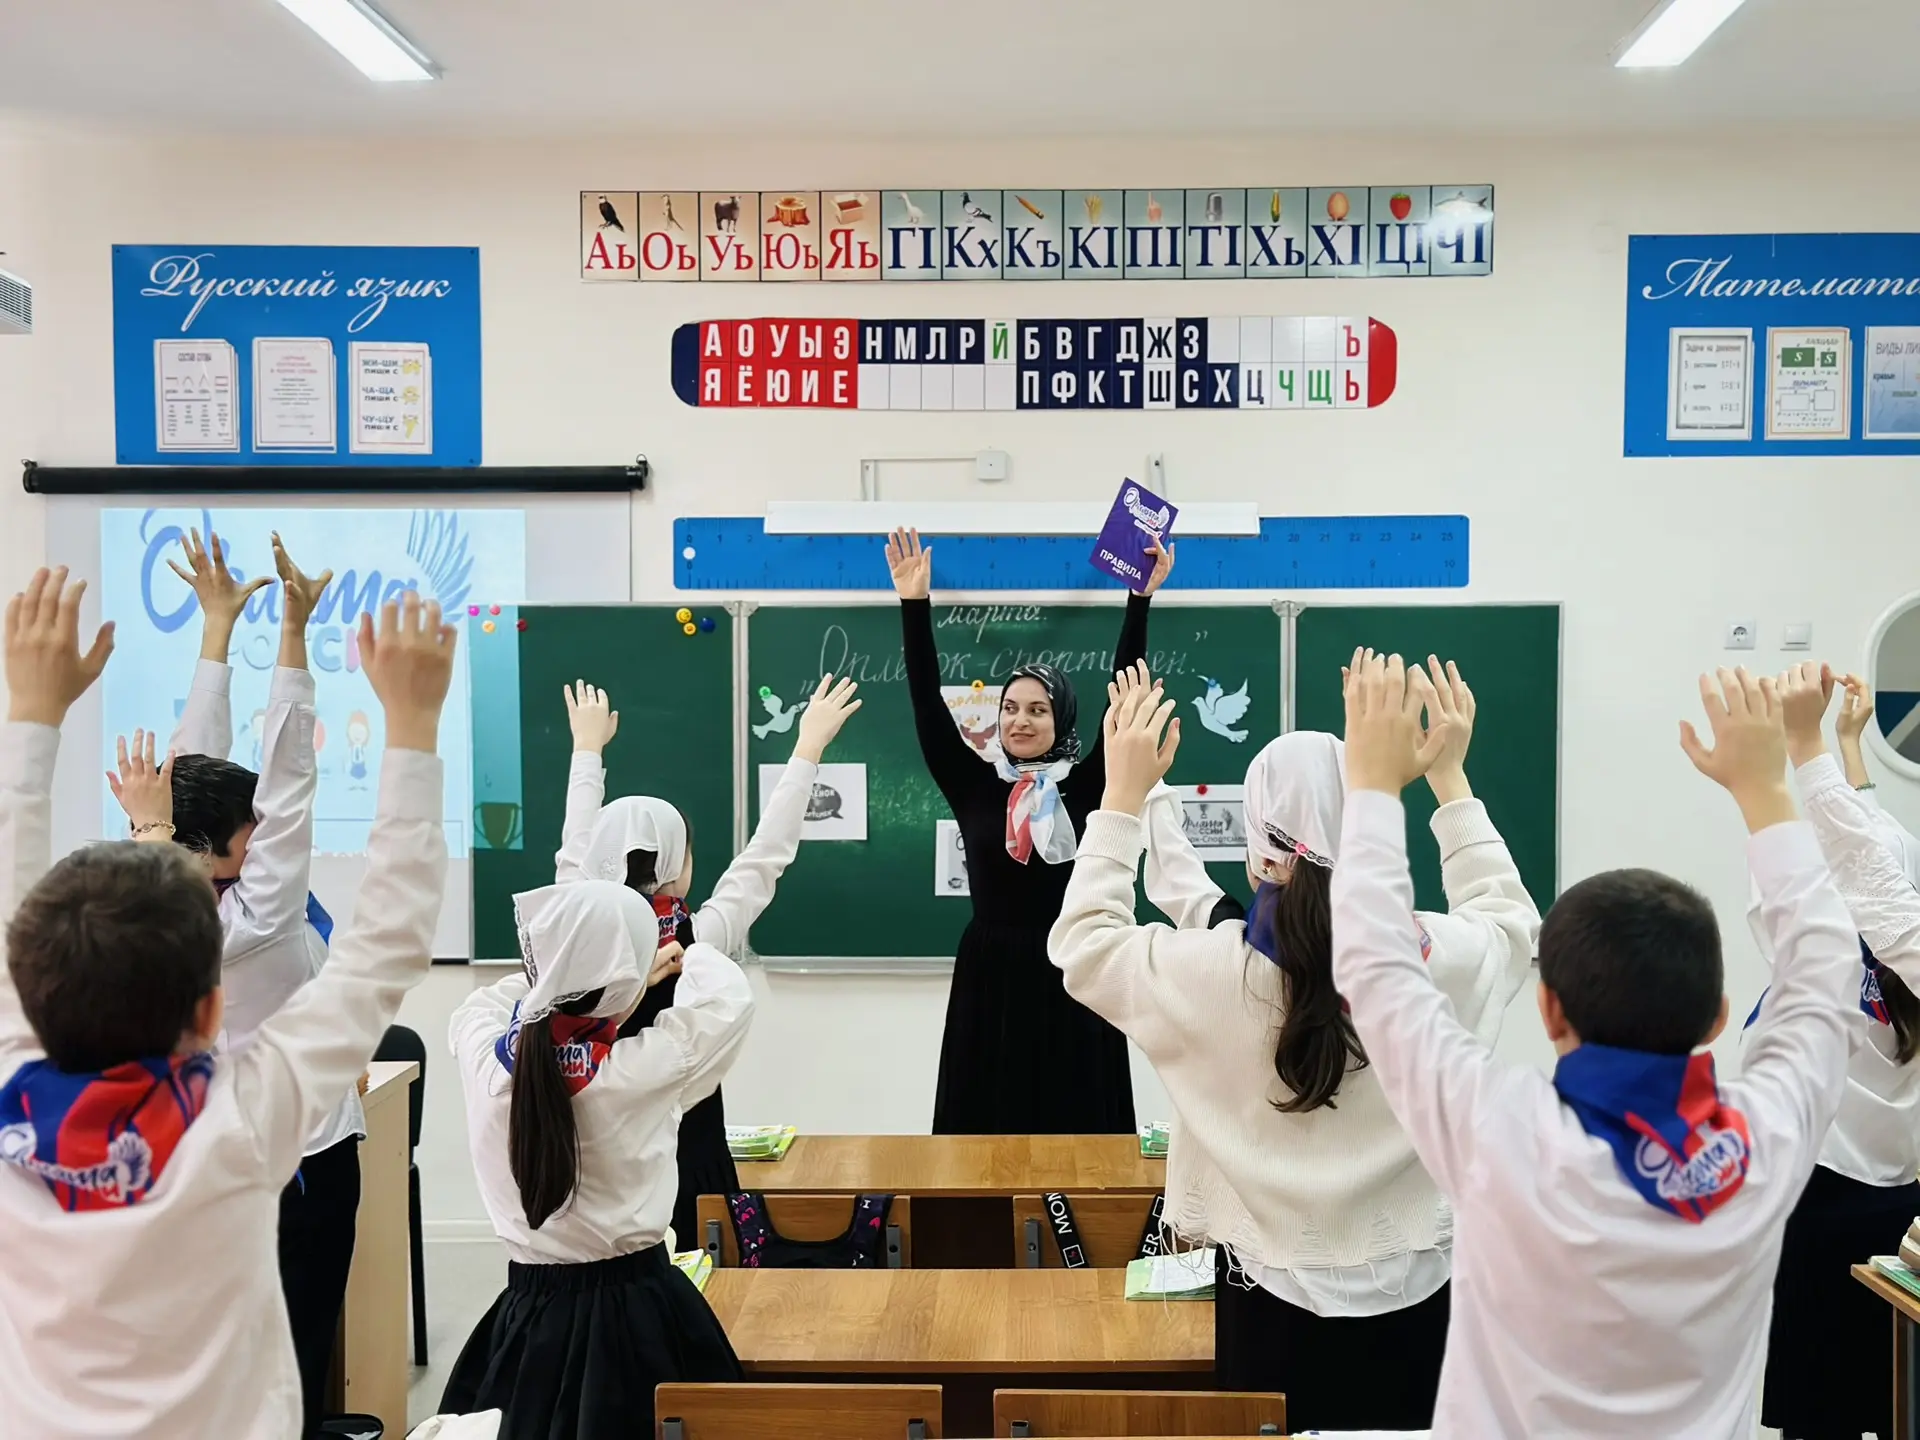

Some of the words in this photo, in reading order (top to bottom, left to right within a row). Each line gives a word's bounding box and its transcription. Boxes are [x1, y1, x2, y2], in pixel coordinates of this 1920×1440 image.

[584, 231, 636, 271] Аь
[642, 231, 697, 271] Оь
[705, 233, 755, 272] Уь
[762, 233, 819, 271] Юь
[824, 228, 879, 270] Яь
[944, 226, 999, 269] Кх
[1005, 226, 1061, 269] Къ
[1249, 225, 1306, 267] Хь
[140, 253, 339, 333] Русский
[345, 277, 452, 333] язык
[704, 323, 723, 357] А
[737, 324, 754, 358] О
[768, 325, 790, 358] У
[800, 325, 822, 358] Ы
[832, 326, 850, 359] Э
[866, 326, 883, 359] Н
[894, 326, 917, 359] М
[925, 327, 947, 359] Л
[959, 327, 975, 359] Р
[992, 322, 1008, 359] Й
[1024, 326, 1041, 359] Б
[1056, 326, 1072, 359] В
[1087, 326, 1102, 359] Г
[1115, 326, 1140, 363] Д
[1147, 325, 1173, 359] Ж
[1183, 325, 1200, 358] З
[1342, 324, 1360, 358] Ъ
[704, 369, 721, 401] Я
[737, 364, 753, 402] Ё
[766, 369, 791, 402] Ю
[802, 370, 818, 402] И
[833, 370, 848, 403] Е
[1023, 370, 1039, 403] П
[1051, 369, 1077, 403] Ф
[1088, 370, 1105, 403] К
[1118, 370, 1136, 403] Т
[1148, 370, 1171, 402] Ш
[1183, 369, 1200, 402] С
[1213, 370, 1232, 402] Х
[1247, 370, 1264, 405] Ц
[1279, 370, 1294, 401] Ч
[1308, 370, 1333, 404] Щ
[1345, 370, 1360, 401] Ь
[1099, 548, 1142, 581] ПРАВИЛА
